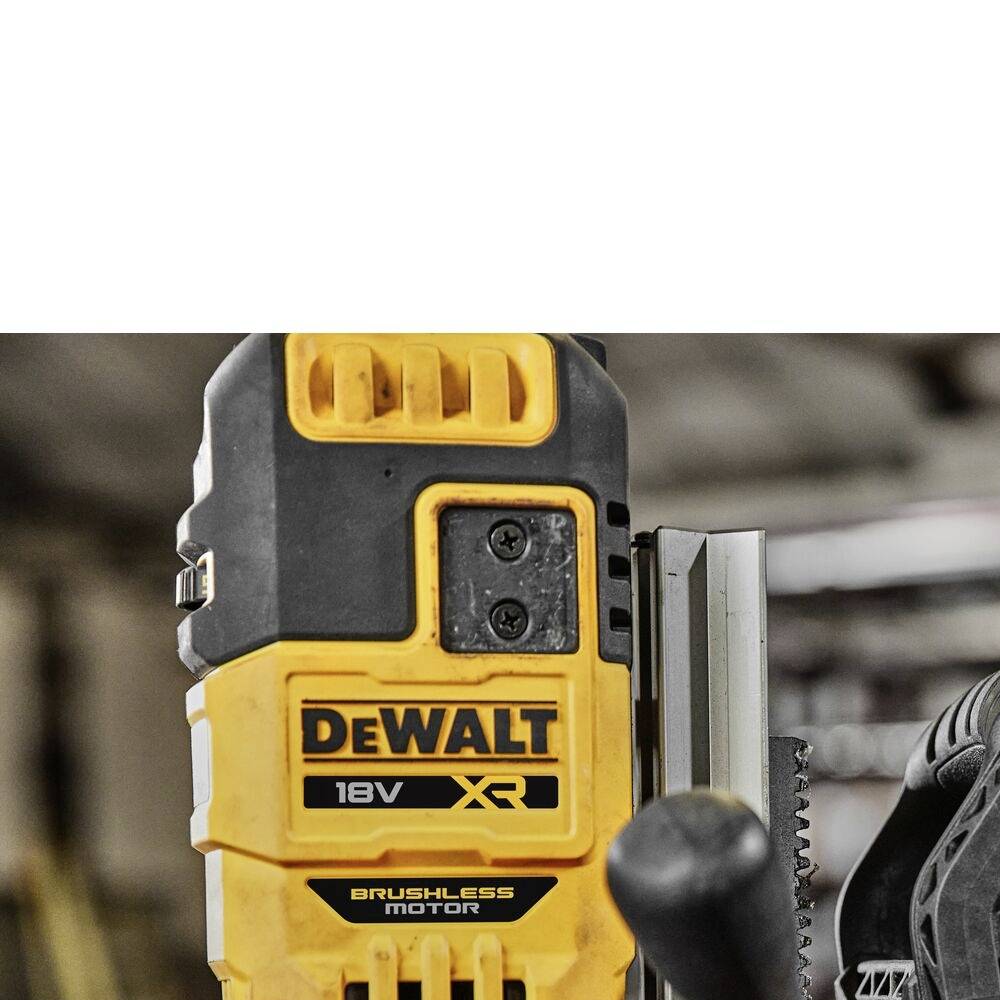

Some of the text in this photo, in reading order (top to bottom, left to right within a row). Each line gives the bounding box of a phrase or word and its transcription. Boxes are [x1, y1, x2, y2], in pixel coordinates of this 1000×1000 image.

[336, 775, 529, 810] 18V XR
[350, 886, 515, 900] BRUSHLESS
[385, 902, 480, 915] MOTOR
